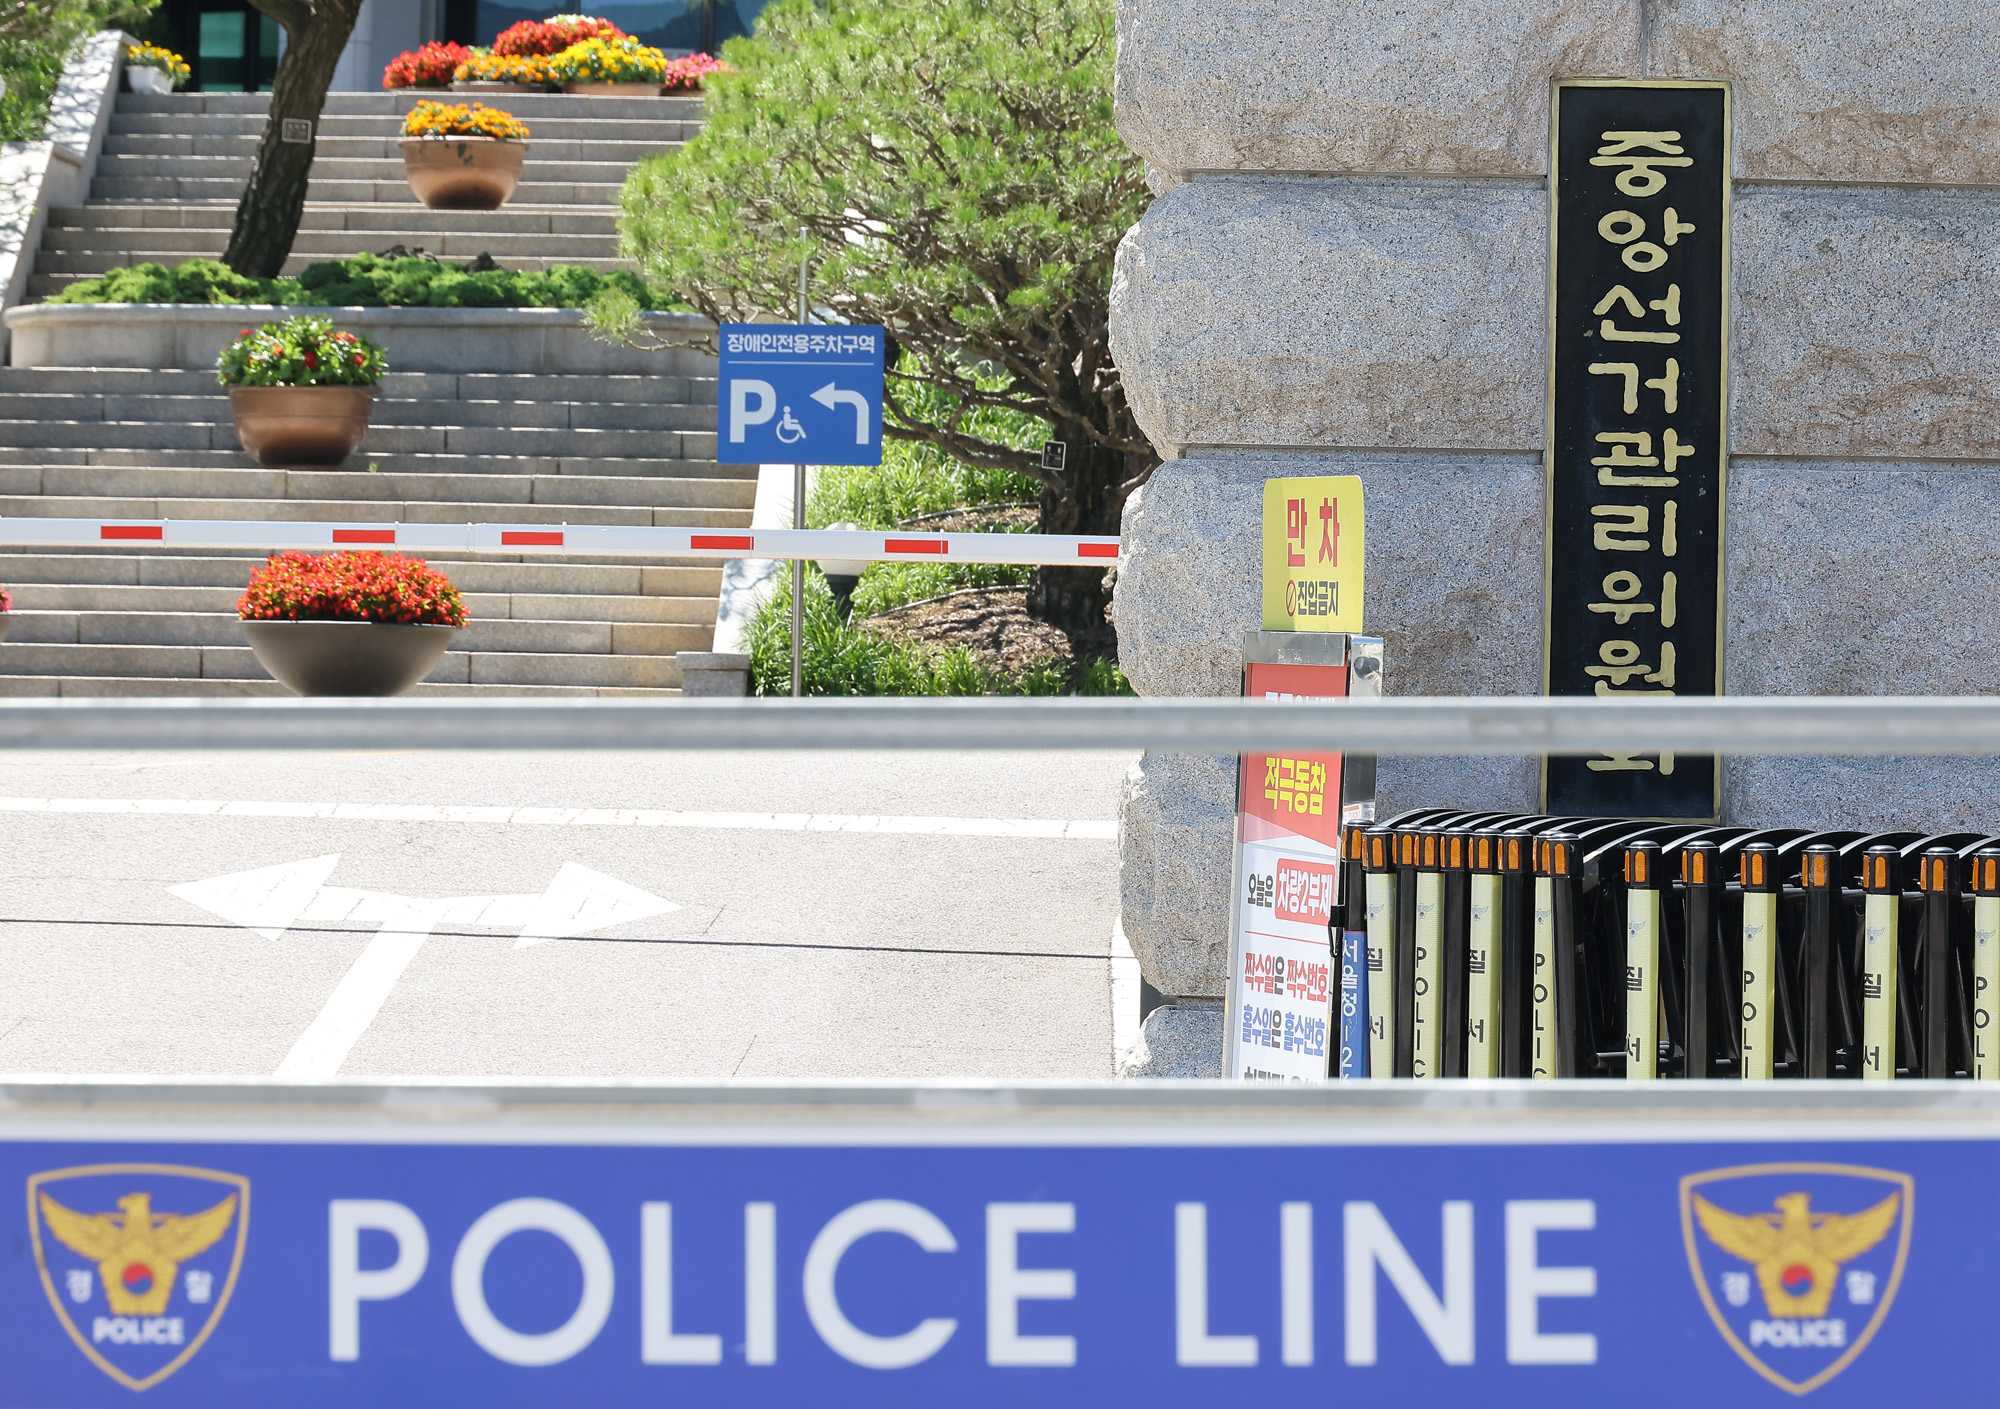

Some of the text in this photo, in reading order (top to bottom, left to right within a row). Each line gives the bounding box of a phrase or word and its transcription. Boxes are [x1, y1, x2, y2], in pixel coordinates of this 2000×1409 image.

[727, 333, 875, 354] 장애인전용주차구역
[730, 379, 776, 443] P
[1297, 581, 1339, 616] 진입금지
[1264, 757, 1327, 816] 적극동참
[1247, 868, 1333, 921] 오늘은 차량2부제
[1244, 952, 1328, 1003] 짝수일은 짝수번호
[1242, 1003, 1326, 1057] 홀수일은 홀수번호
[1341, 939, 1359, 1079] 서울청-2
[328, 1197, 1598, 1368] POLICE LINE
[92, 1316, 185, 1345] POLICE
[1749, 1318, 1847, 1348] POLICE
